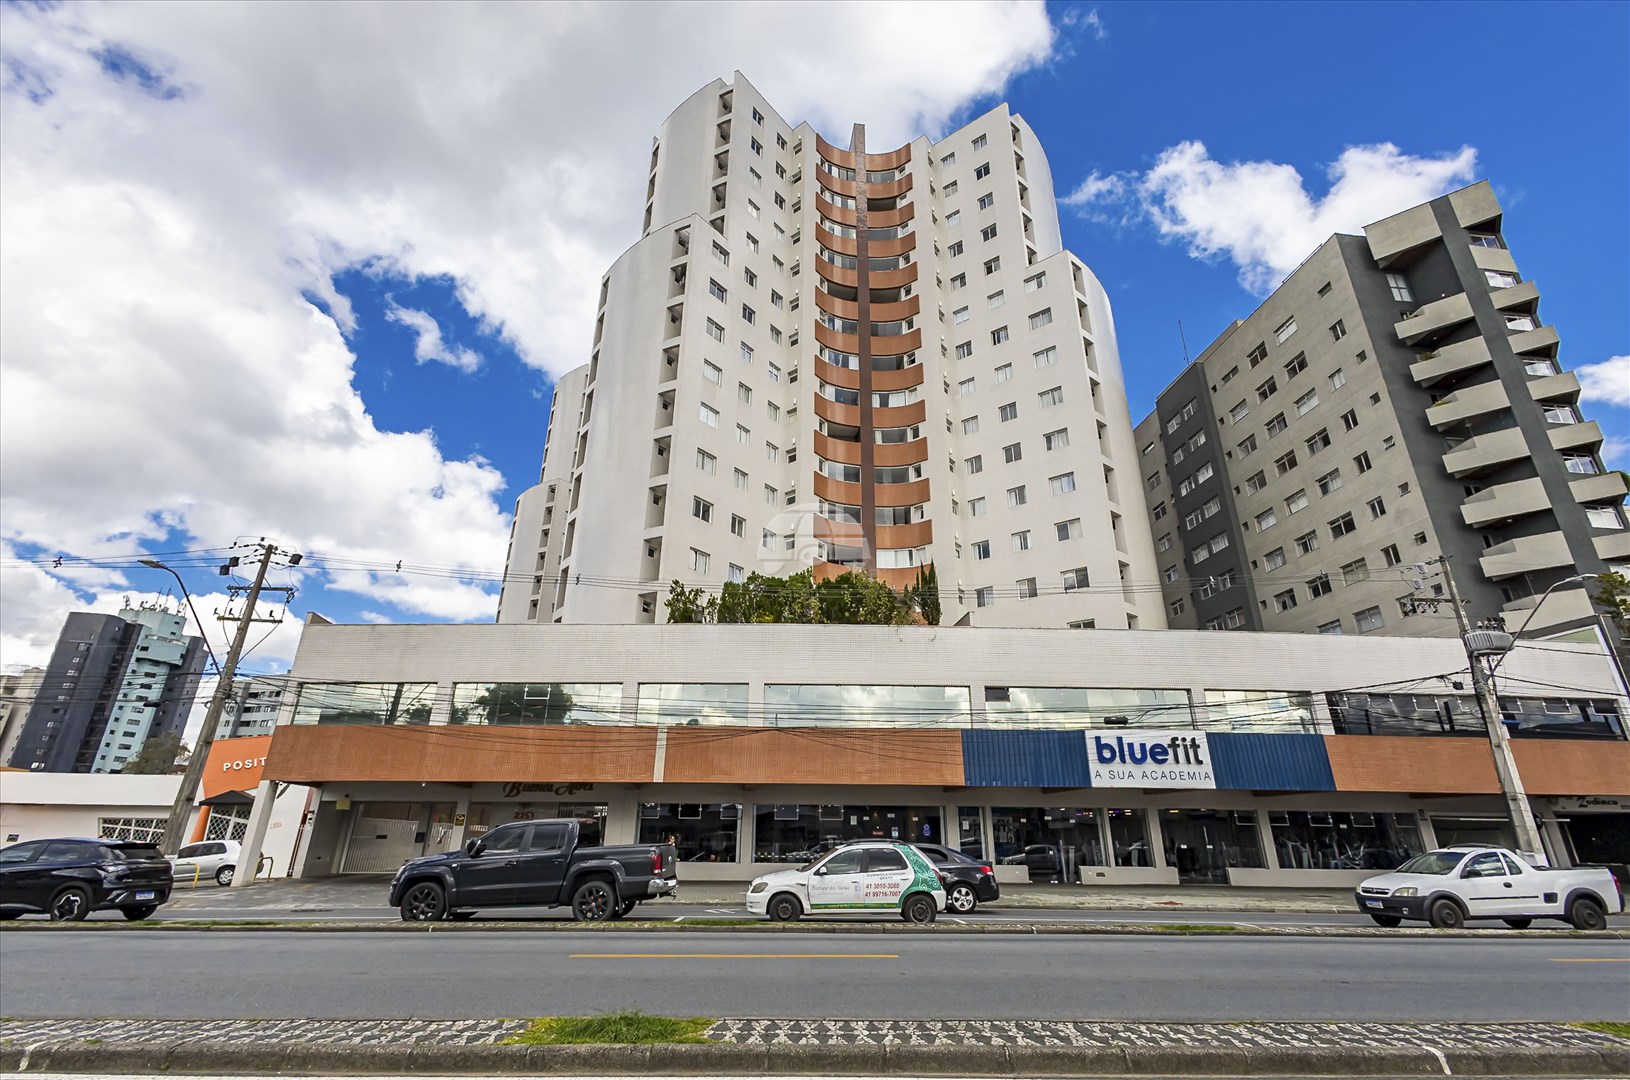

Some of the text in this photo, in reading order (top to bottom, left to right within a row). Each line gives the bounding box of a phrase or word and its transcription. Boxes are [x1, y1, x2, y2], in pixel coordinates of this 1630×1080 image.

[1094, 735, 1204, 765] bluefit
[223, 756, 267, 771] POSIT
[1094, 769, 1212, 781] A SUA ACADEMIA
